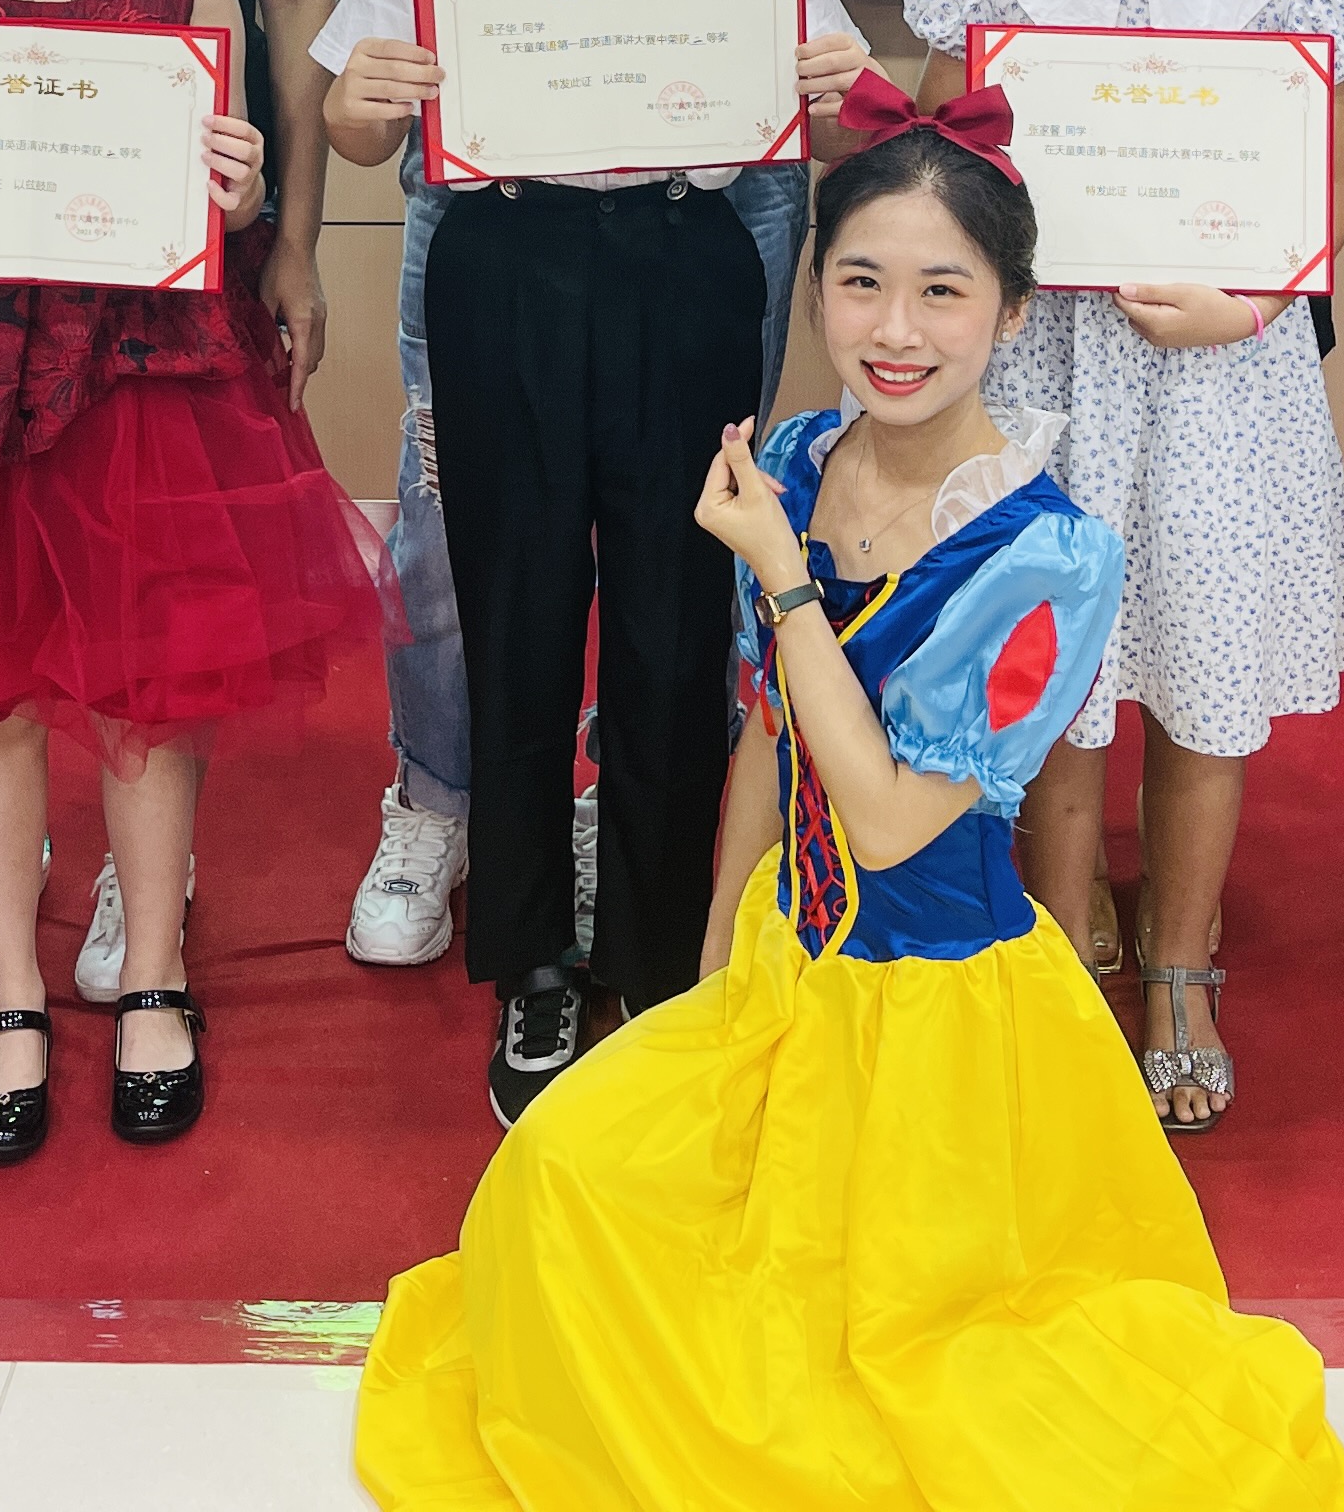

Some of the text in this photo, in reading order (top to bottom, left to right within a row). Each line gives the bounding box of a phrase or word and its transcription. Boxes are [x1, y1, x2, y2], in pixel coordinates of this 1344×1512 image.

[522, 22, 545, 34] 同学
[1091, 83, 1220, 107] 荣誉证书
[1065, 124, 1087, 137] 同学
